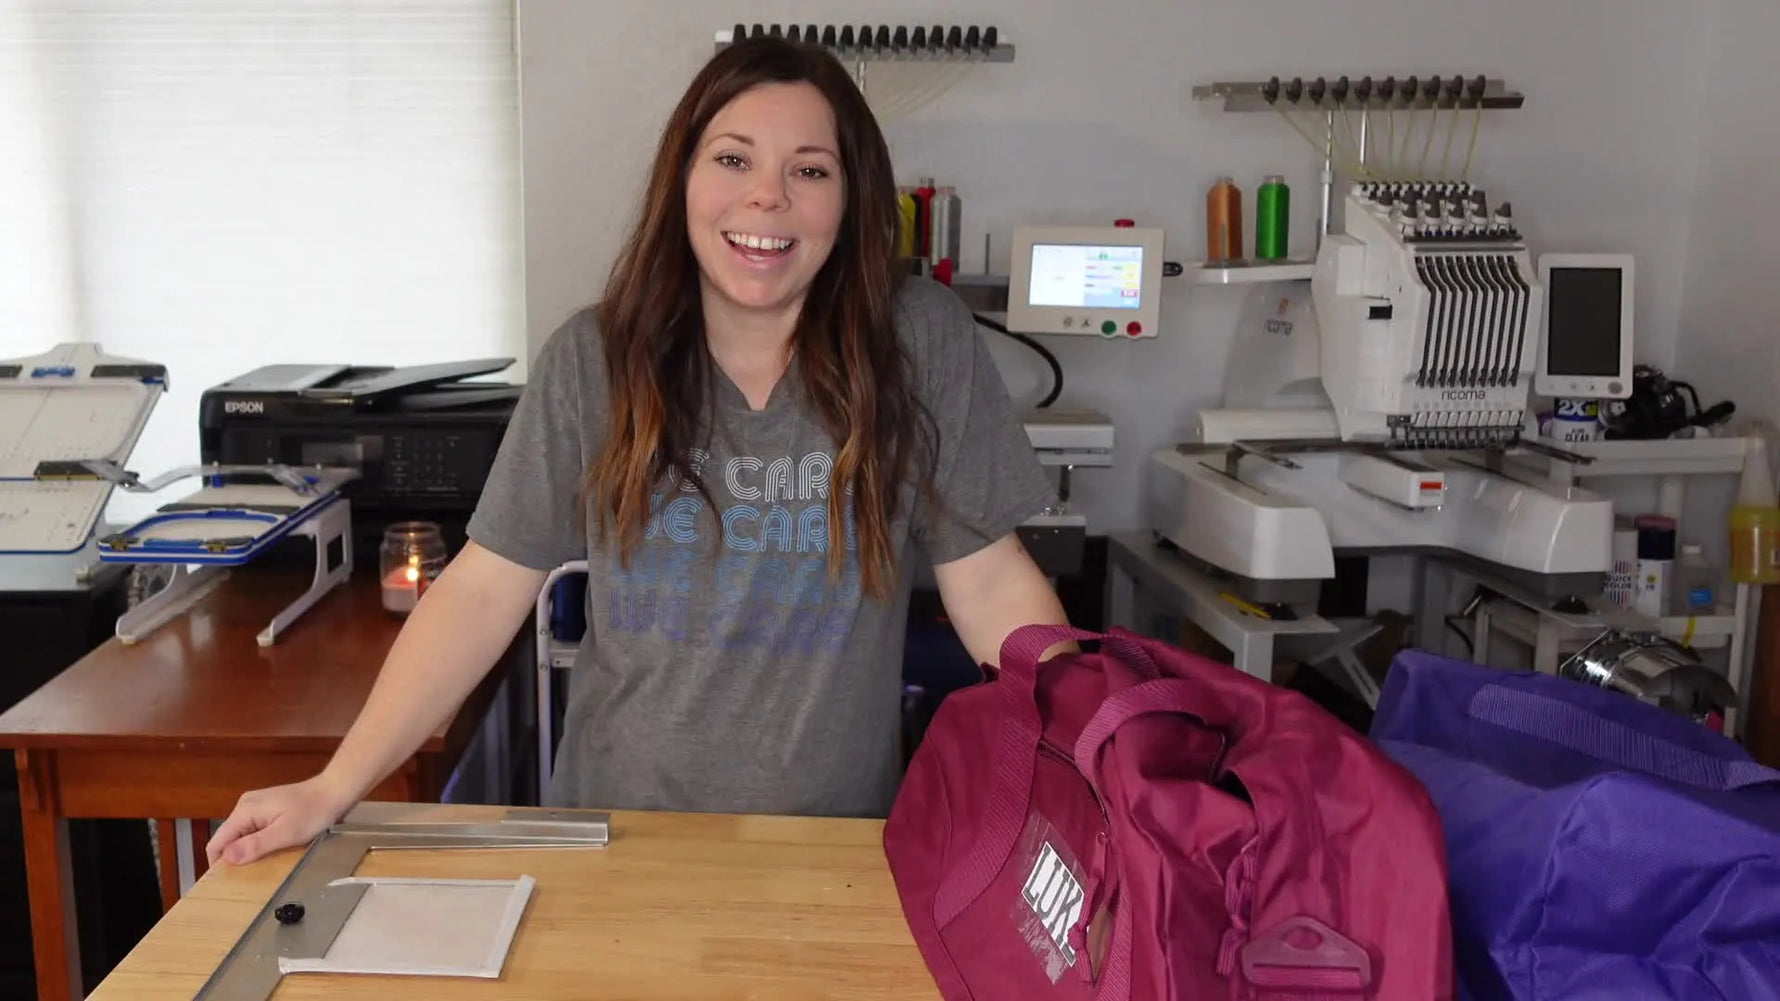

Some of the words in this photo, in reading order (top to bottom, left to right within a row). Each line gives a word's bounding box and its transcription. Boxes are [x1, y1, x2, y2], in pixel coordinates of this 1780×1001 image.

[224, 401, 265, 413] EPSON
[1441, 390, 1486, 401] ricoma
[725, 452, 854, 502] CAR
[722, 505, 856, 552] CAR
[1021, 840, 1084, 967] LUK
